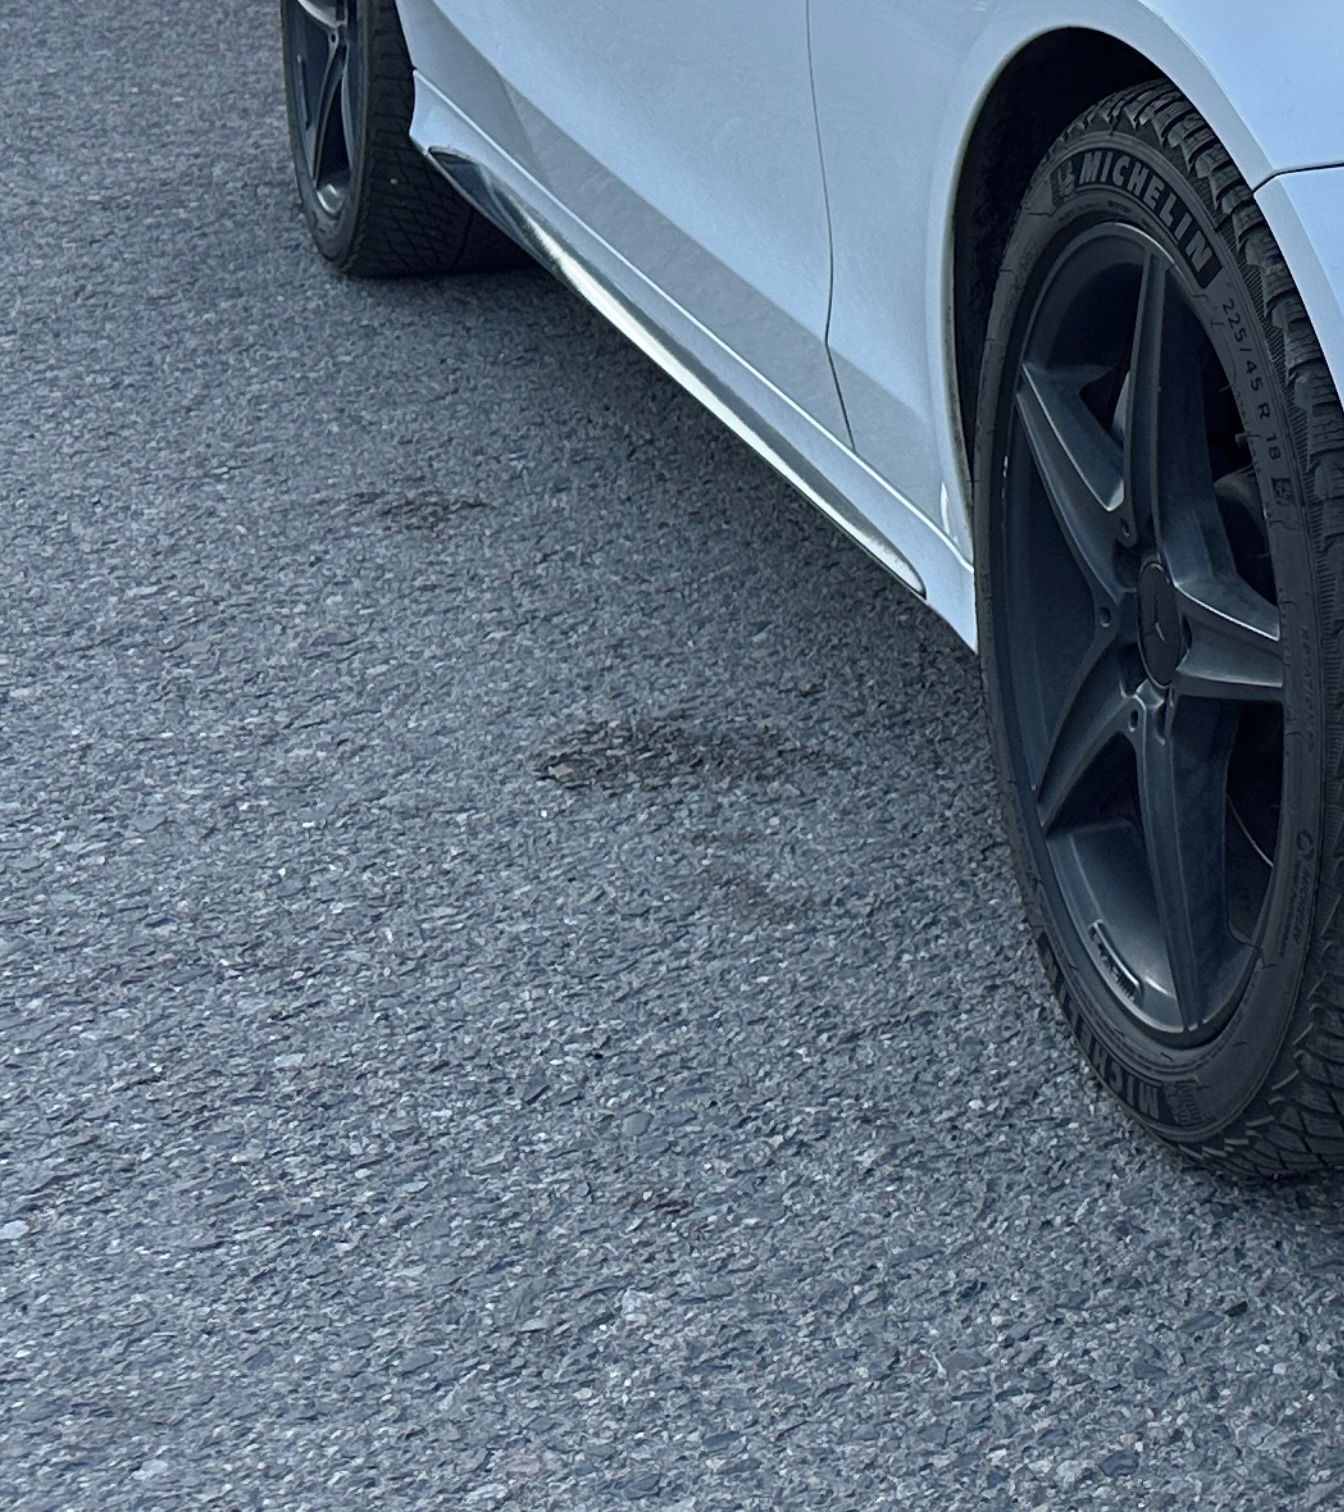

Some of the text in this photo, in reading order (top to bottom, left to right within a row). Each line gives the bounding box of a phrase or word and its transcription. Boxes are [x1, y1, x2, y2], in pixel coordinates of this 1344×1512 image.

[1079, 151, 1213, 272] MICHELIN
[1222, 298, 1264, 392] 225/45
[1257, 403, 1271, 420] R
[1265, 432, 1281, 461] 18
